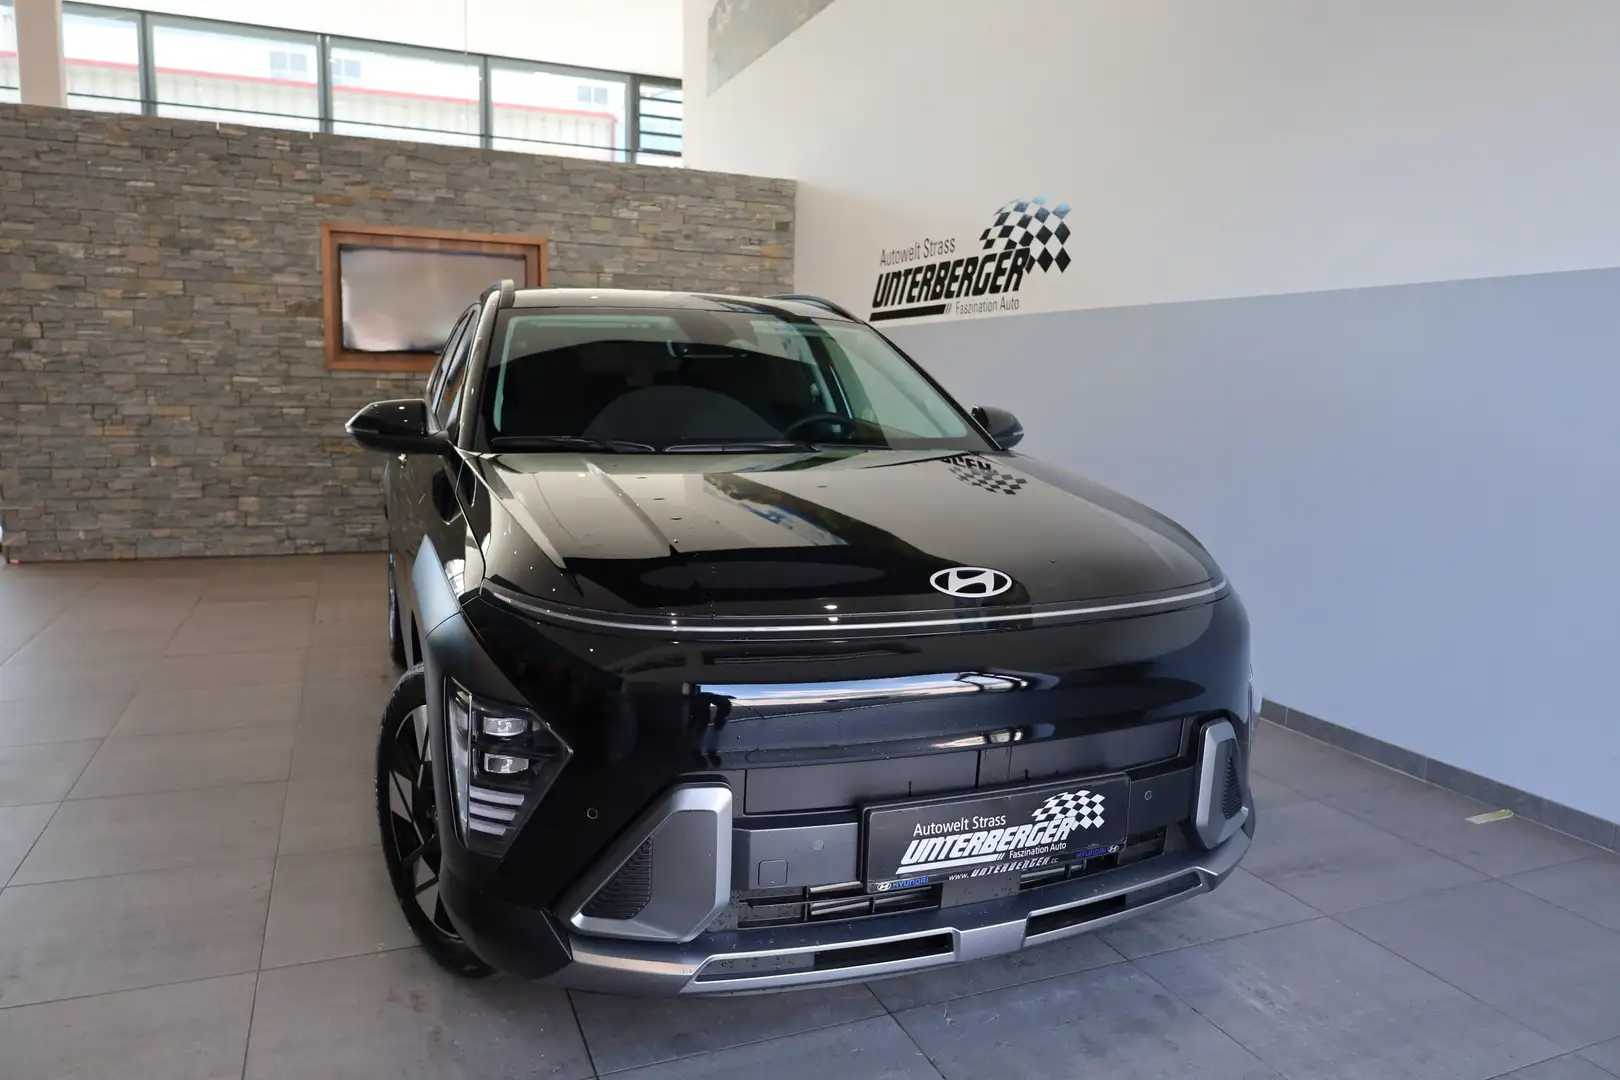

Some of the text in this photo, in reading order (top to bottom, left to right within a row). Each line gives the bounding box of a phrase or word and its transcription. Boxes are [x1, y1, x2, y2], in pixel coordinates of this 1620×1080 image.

[879, 237, 956, 267] Autowelt Strass
[872, 247, 1031, 309] UNTERBERGER
[955, 297, 1020, 315] Faszination Auto
[913, 815, 1007, 837] Autowelt Strass
[900, 816, 1077, 865] UNTERBERGER
[1009, 842, 1067, 860] Faszination Auto
[892, 877, 929, 889] HYUNDAI
